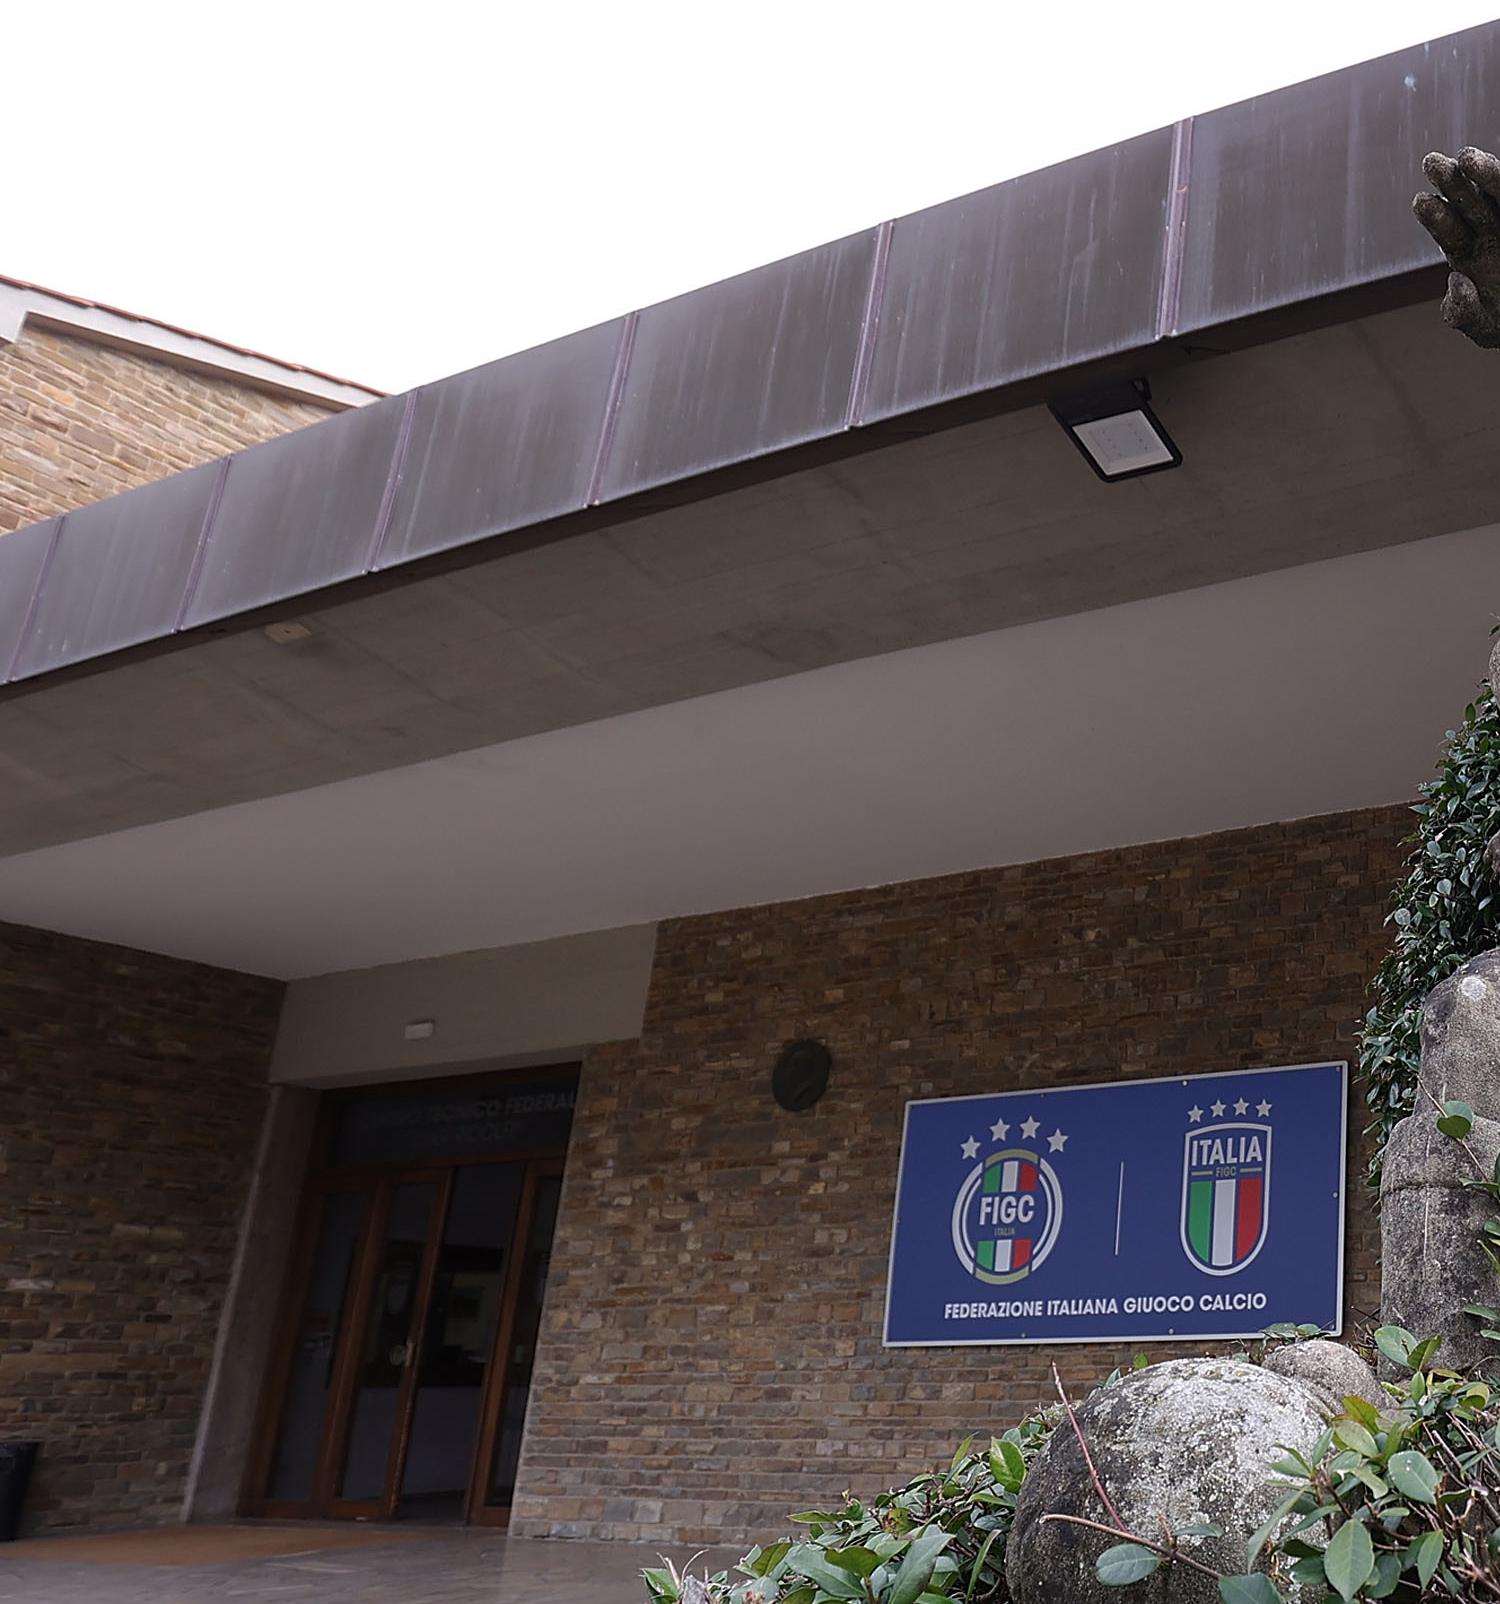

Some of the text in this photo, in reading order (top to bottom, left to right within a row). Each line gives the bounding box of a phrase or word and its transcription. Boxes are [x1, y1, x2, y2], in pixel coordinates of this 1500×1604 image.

[1191, 1135, 1263, 1166] ITALIA
[1215, 1166, 1237, 1177] FIGC
[979, 1194, 1035, 1226] FIGC
[994, 1227, 1016, 1236] ITALIA
[944, 1292, 1267, 1319] FEDERAZIONE ITALIANA GIUOCO CALCIO
